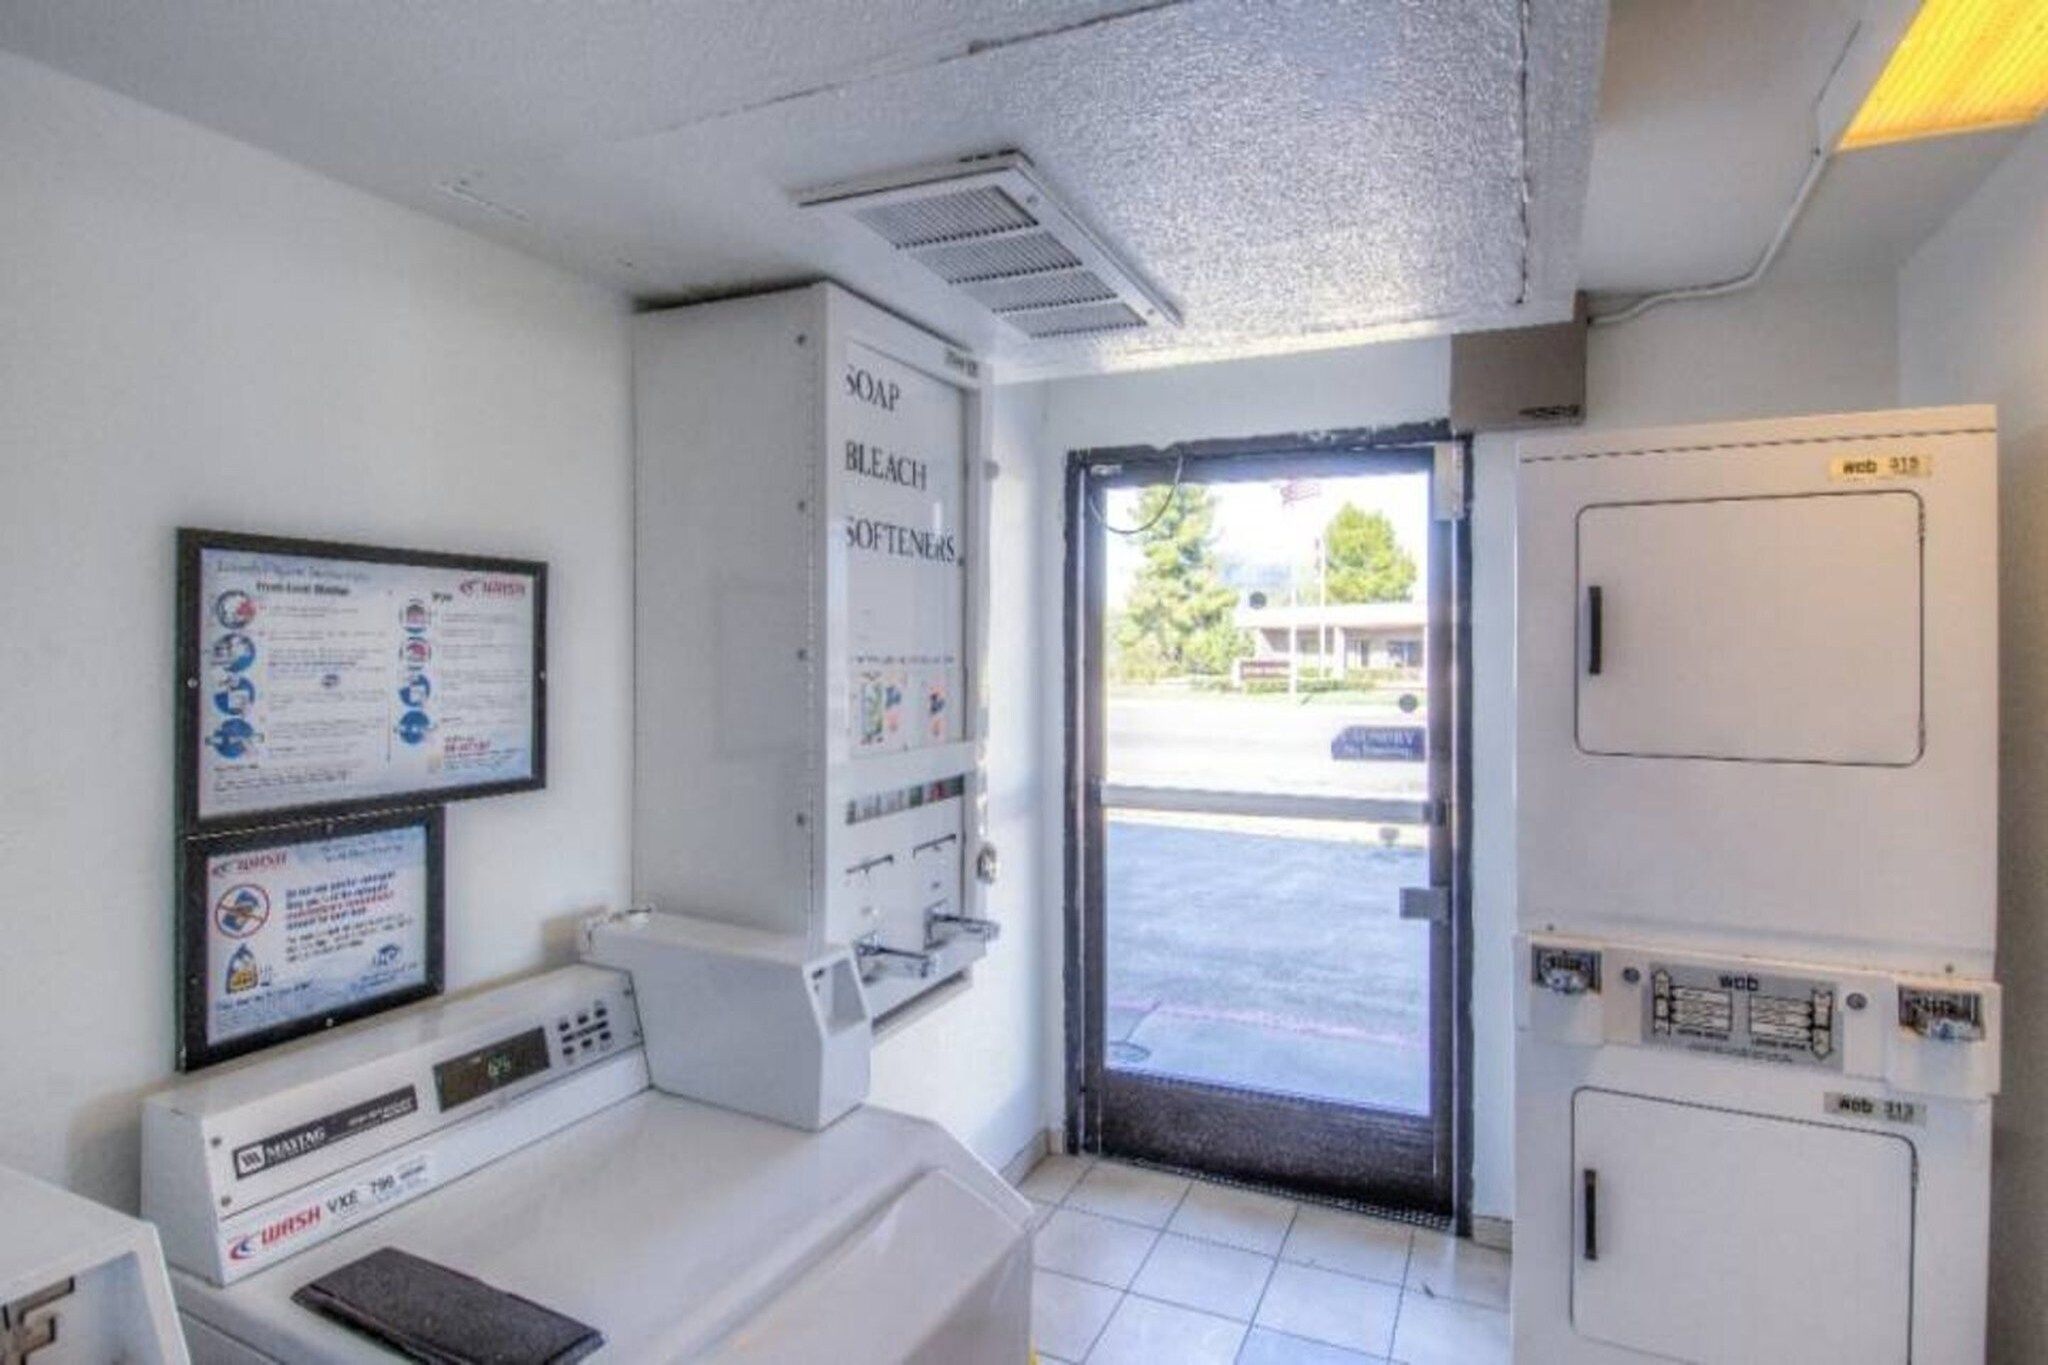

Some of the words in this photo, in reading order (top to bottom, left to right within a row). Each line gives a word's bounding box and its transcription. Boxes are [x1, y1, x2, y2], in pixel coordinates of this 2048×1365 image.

[846, 364, 900, 412] SOAP
[845, 438, 928, 491] BLEACH
[846, 515, 956, 563] SOFTENERS
[265, 1127, 326, 1164] MAYTAG
[261, 1206, 322, 1245] WASH
